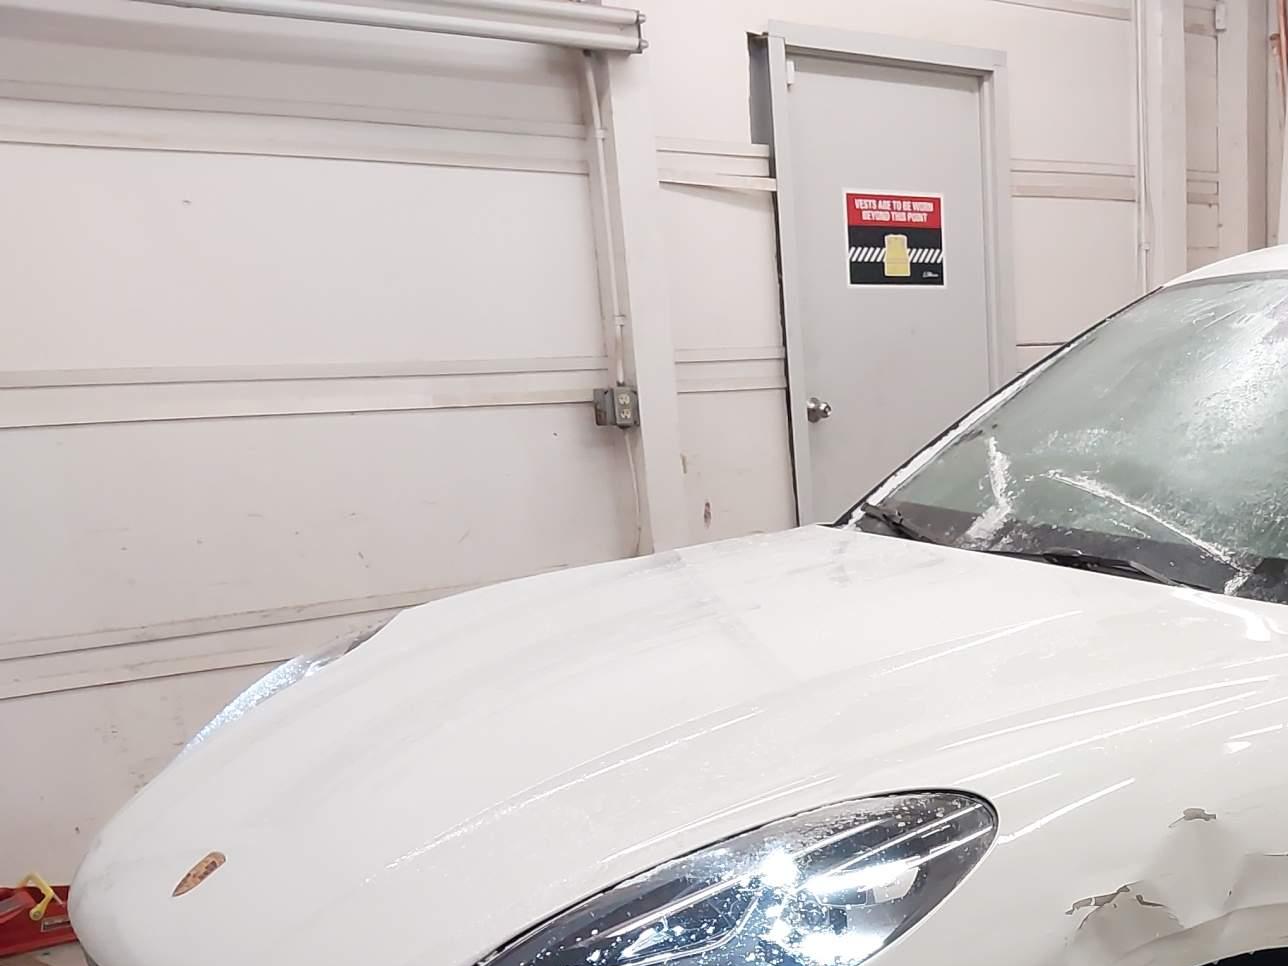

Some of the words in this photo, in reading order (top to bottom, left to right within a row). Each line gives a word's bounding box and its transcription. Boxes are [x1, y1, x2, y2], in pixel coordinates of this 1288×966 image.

[854, 198, 877, 210] VESTS
[878, 199, 892, 211] ARE
[892, 200, 902, 211] TO
[902, 201, 912, 212] BE
[861, 210, 891, 221] BEYOND
